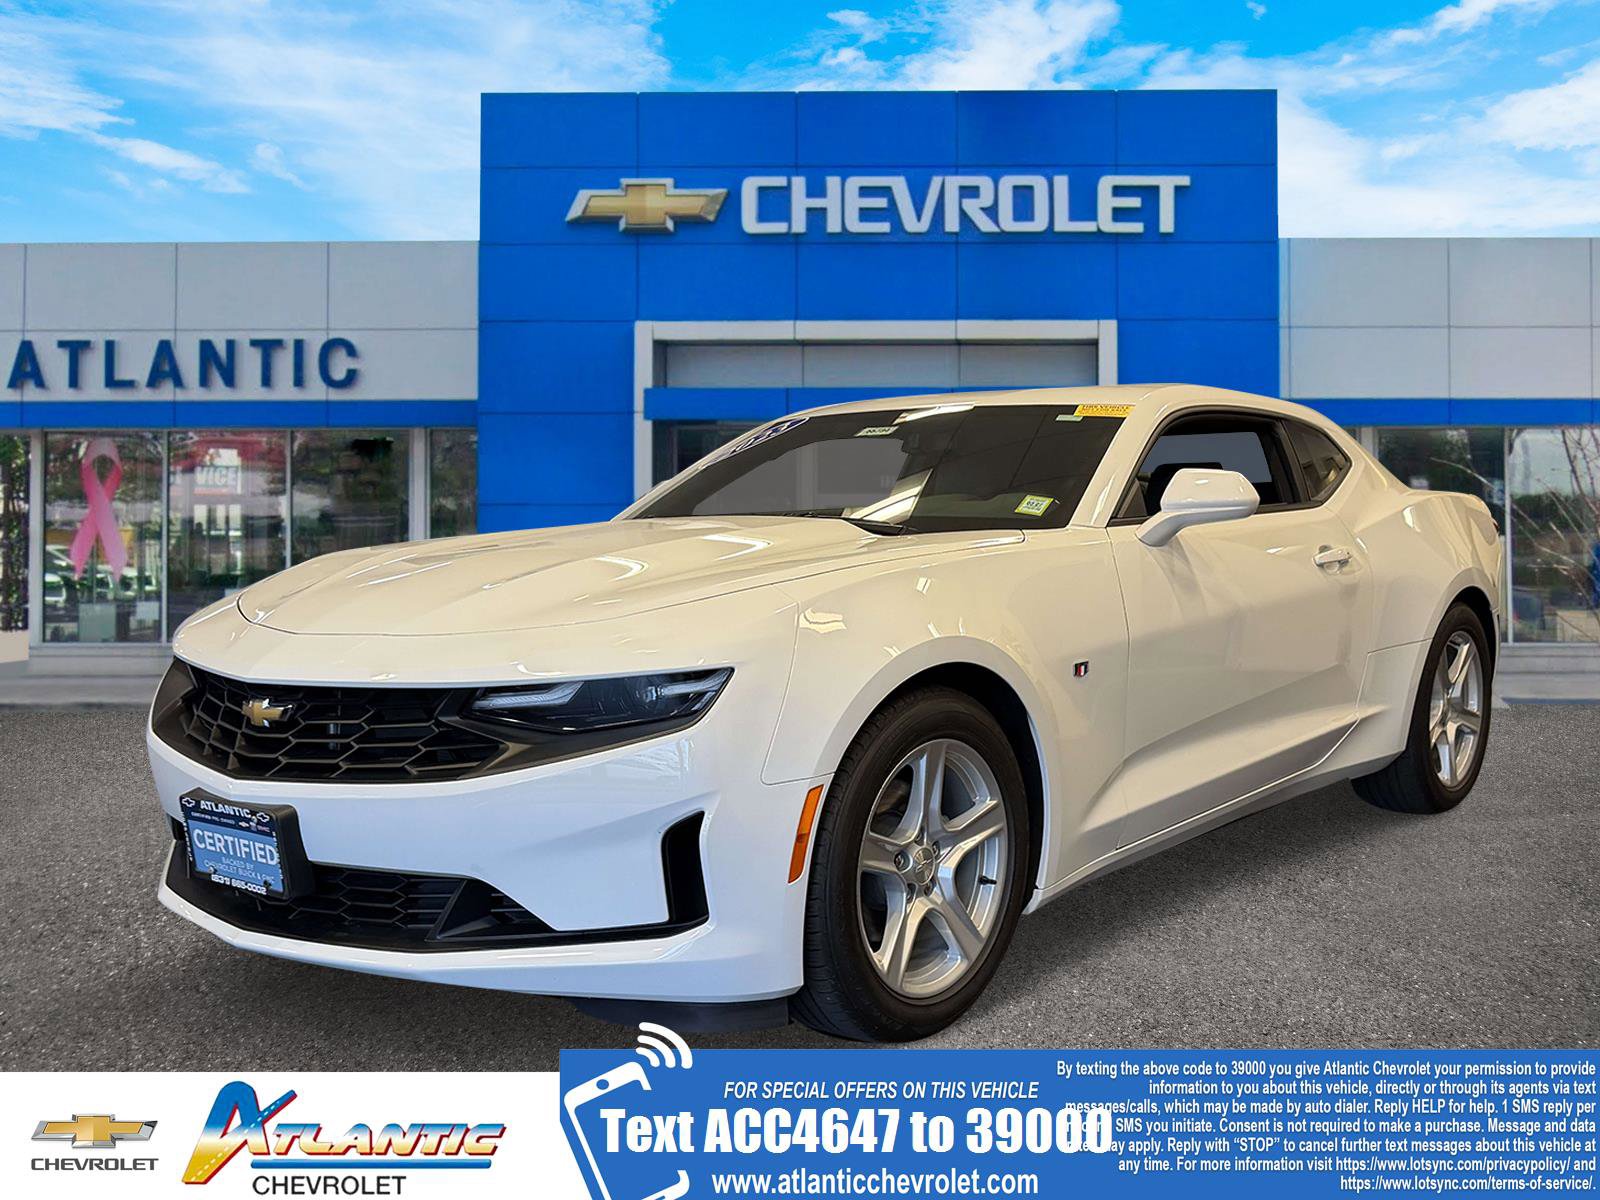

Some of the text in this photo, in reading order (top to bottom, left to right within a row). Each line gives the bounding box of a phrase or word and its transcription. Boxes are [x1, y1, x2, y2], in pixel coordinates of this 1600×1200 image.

[740, 175, 1191, 234] CHEVROLET
[7, 337, 360, 390] ATLANTIC
[200, 800, 252, 819] ATLANTIC
[193, 829, 278, 865] CERTIFIED
